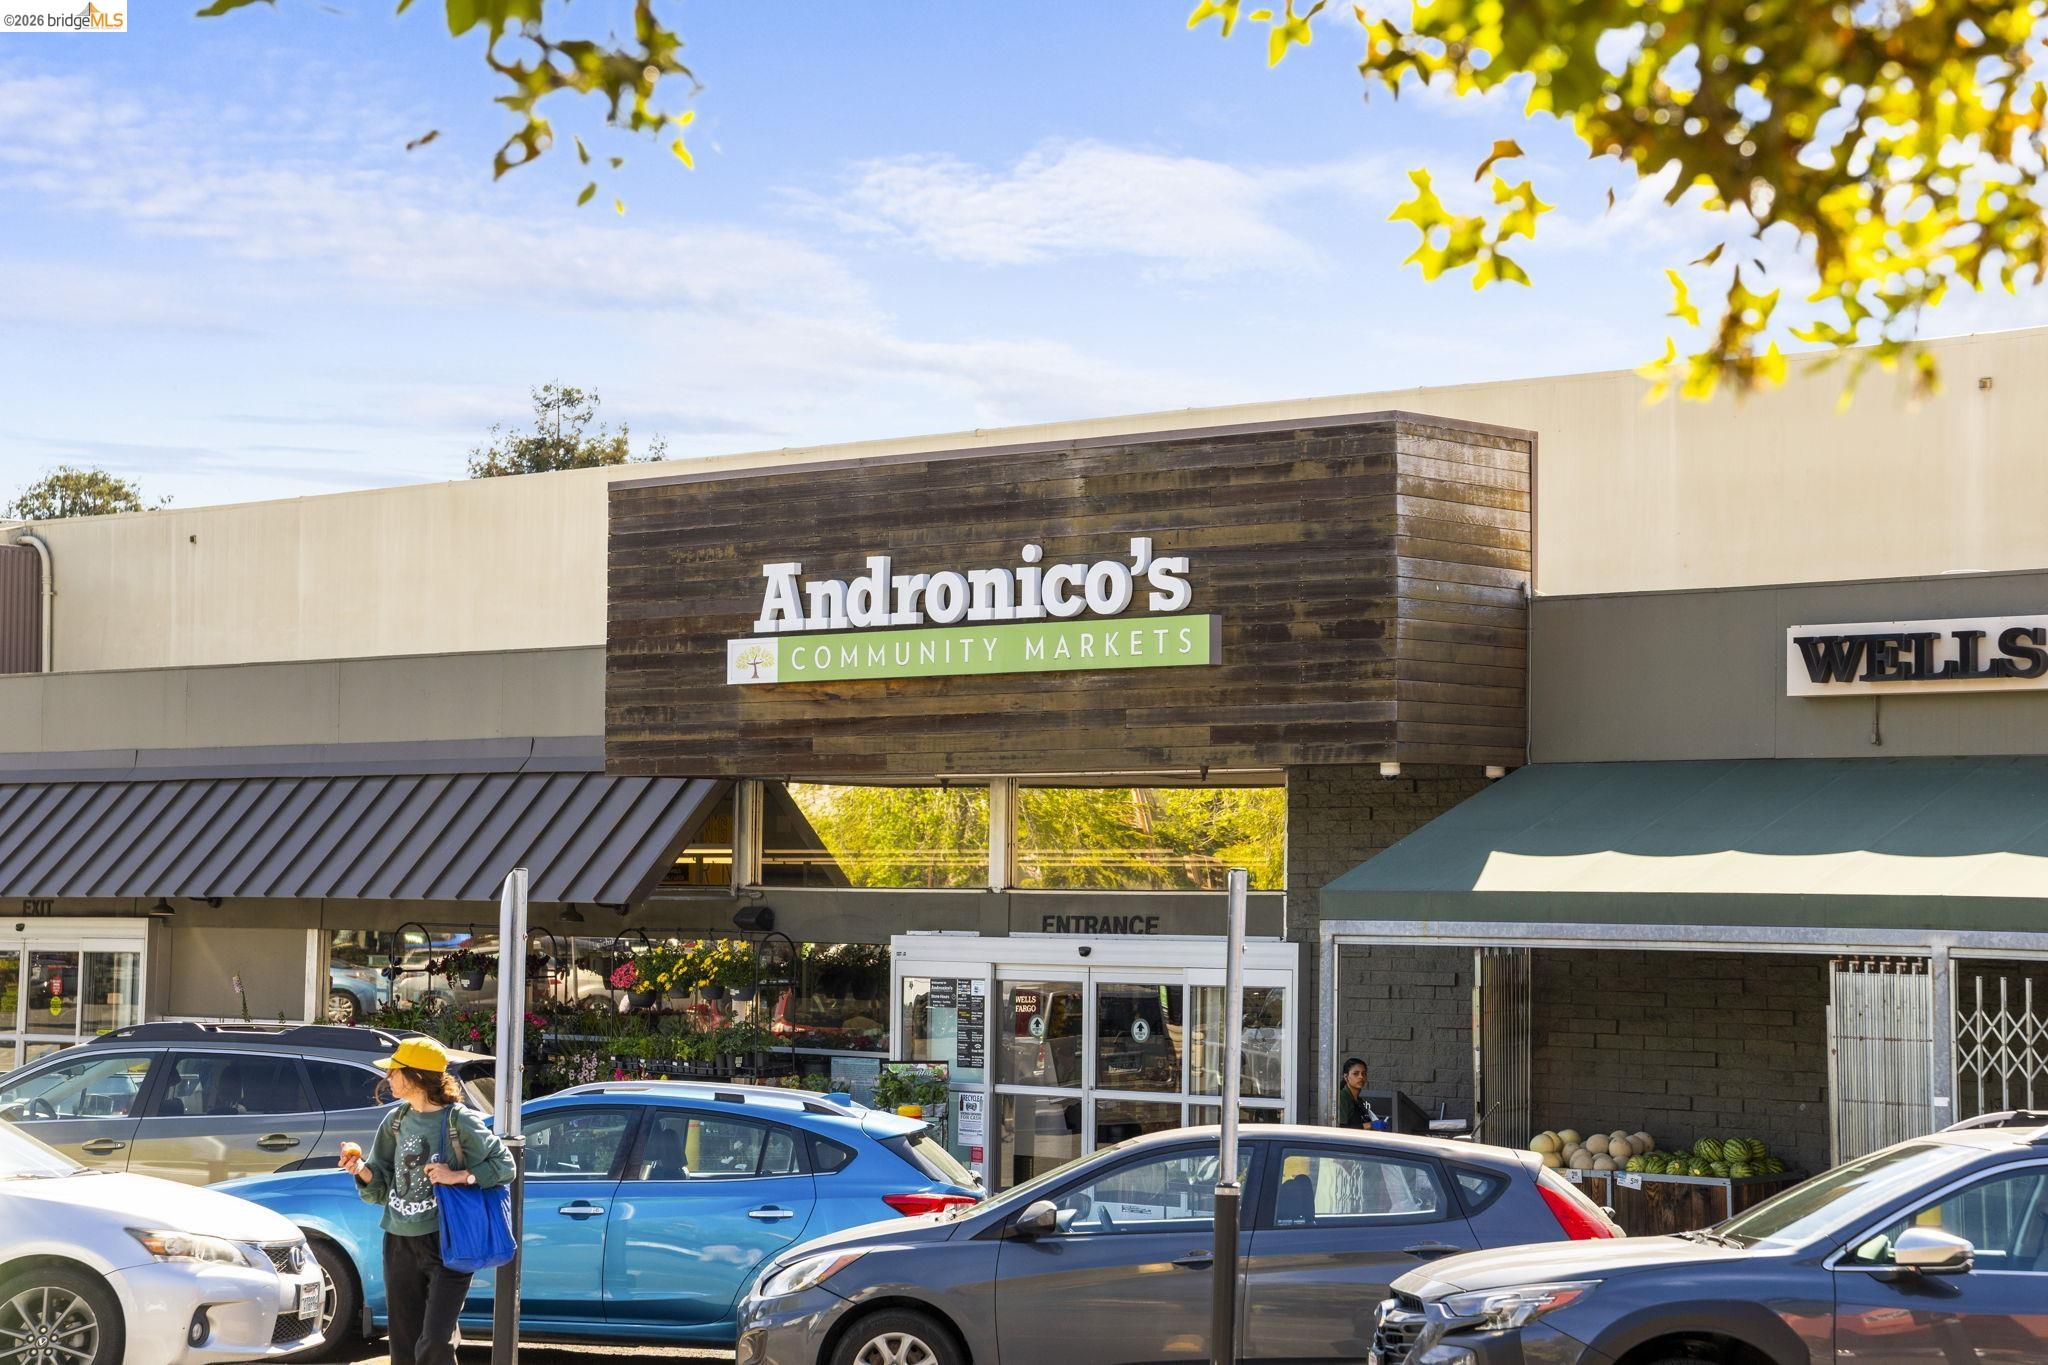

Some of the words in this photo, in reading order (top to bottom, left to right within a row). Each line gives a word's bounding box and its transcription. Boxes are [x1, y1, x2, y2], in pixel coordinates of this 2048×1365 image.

[753, 537, 1193, 632] Andronico's
[791, 637, 998, 671] COMMUNITY
[1025, 627, 1192, 660] MARKETS
[1793, 627, 2048, 683] WELLS
[23, 900, 54, 916] EXIT
[1042, 915, 1160, 934] ENTRANCE
[1015, 995, 1037, 1004] WELLS
[1015, 1004, 1037, 1012] FARGO
